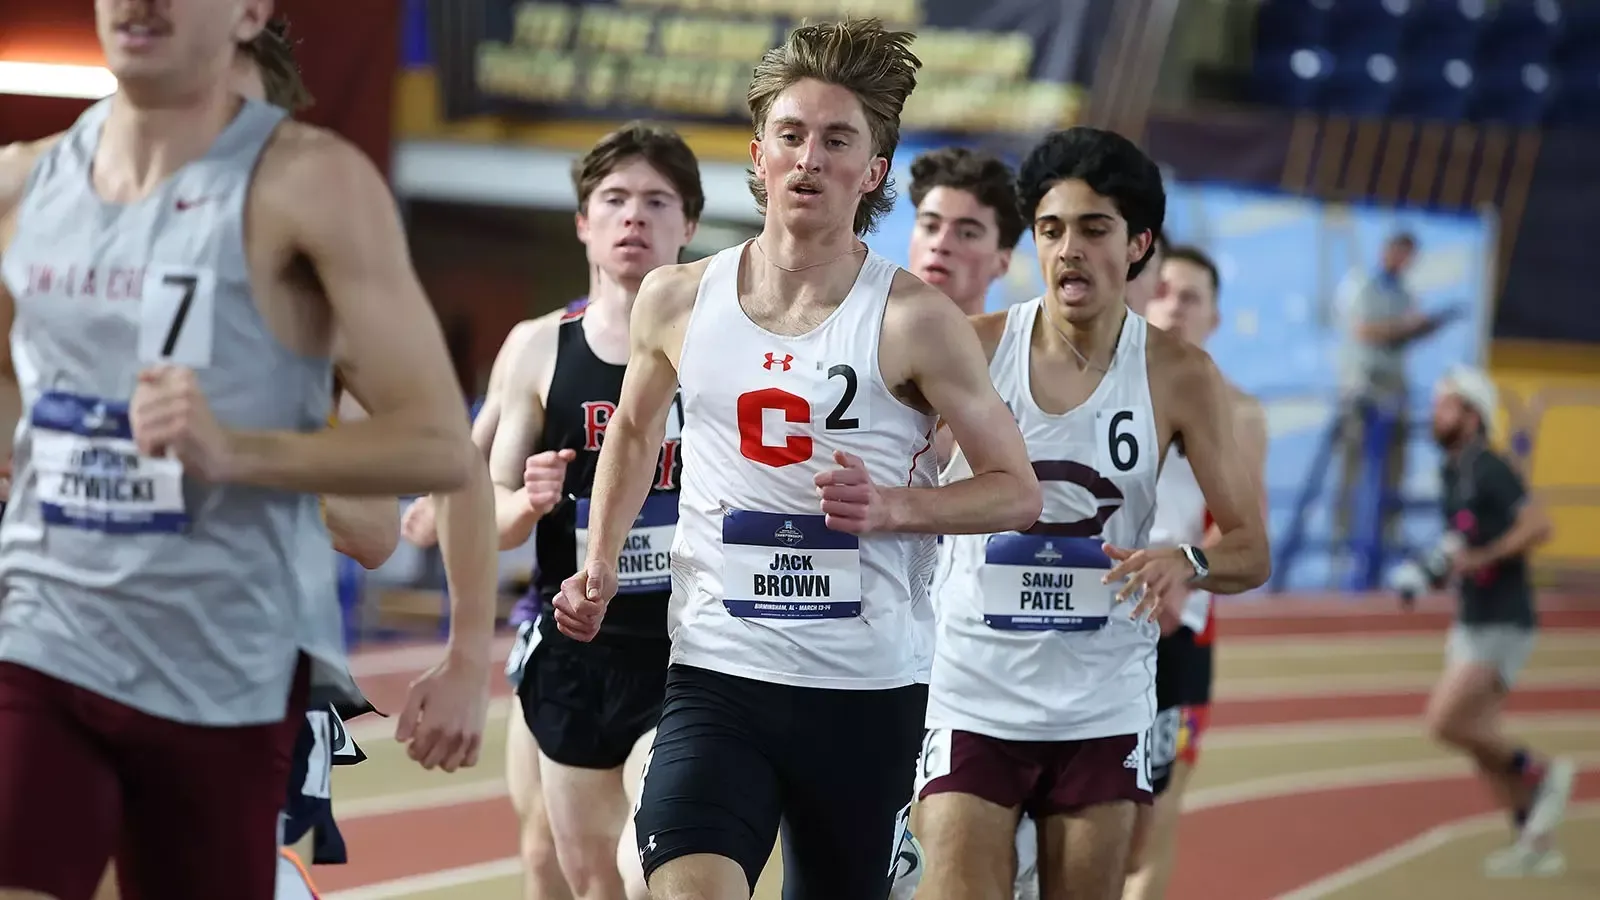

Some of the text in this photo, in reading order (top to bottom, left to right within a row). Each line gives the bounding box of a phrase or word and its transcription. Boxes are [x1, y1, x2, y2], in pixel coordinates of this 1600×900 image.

[162, 273, 198, 357] 7
[825, 364, 859, 430] 2
[737, 387, 814, 468] C
[1108, 410, 1139, 472] 6
[621, 534, 652, 552] ACK
[616, 552, 671, 573] RNEC
[769, 553, 814, 571] JACK
[753, 573, 830, 597] BROWN
[1022, 572, 1074, 588] SANJU
[1020, 591, 1075, 611] PATEL
